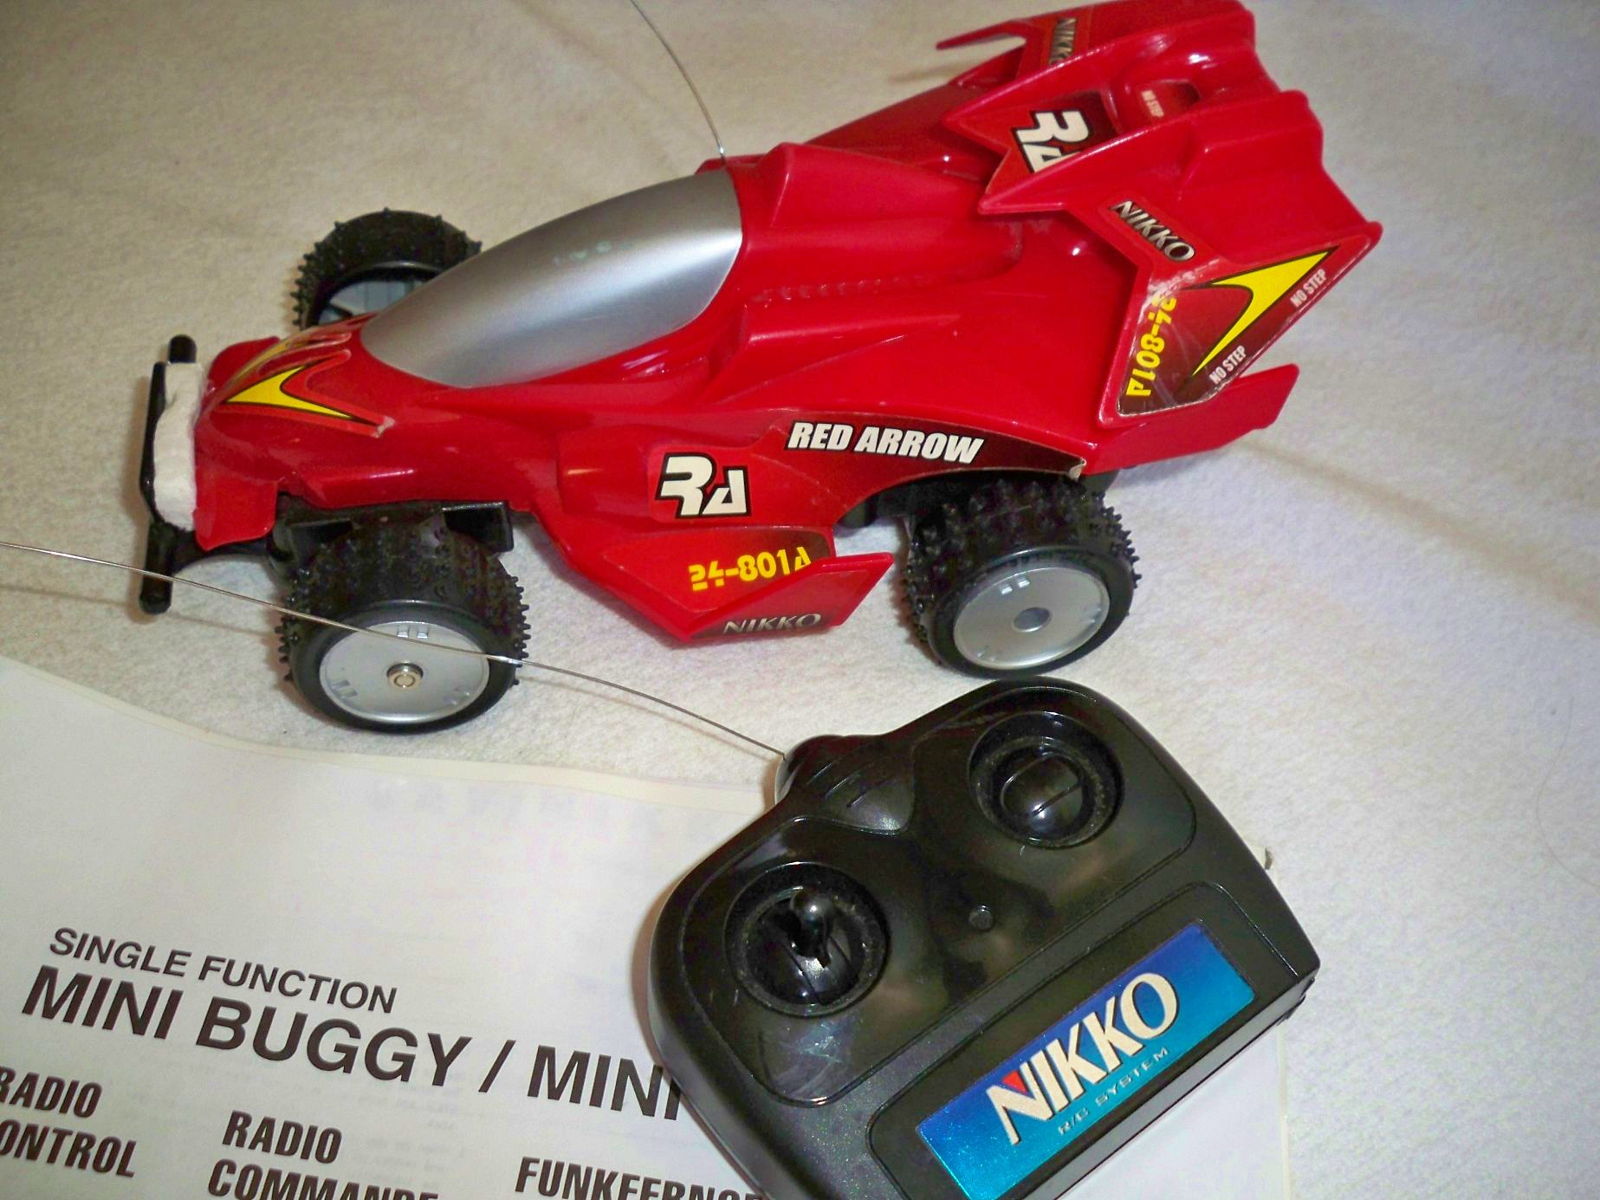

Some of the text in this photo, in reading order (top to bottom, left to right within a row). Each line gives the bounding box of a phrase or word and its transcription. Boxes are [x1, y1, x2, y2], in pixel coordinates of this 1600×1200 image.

[1111, 199, 1196, 262] NIKKO
[1289, 267, 1327, 308] NO STEP
[1208, 344, 1247, 385] NO STEP
[787, 421, 985, 465] RED ARROW
[687, 545, 812, 593] 24-801A
[722, 612, 823, 635] NIKKO
[49, 926, 398, 1015] SINGLE FUNCTION
[20, 964, 185, 1041] MINI
[195, 995, 473, 1088] BUGGY
[526, 1044, 684, 1122] MINI
[985, 972, 1179, 1146] NIKKO
[0, 1065, 103, 1119] RADIO
[1057, 1047, 1169, 1136] R/C SYSTEM
[221, 1109, 343, 1165] RADIO
